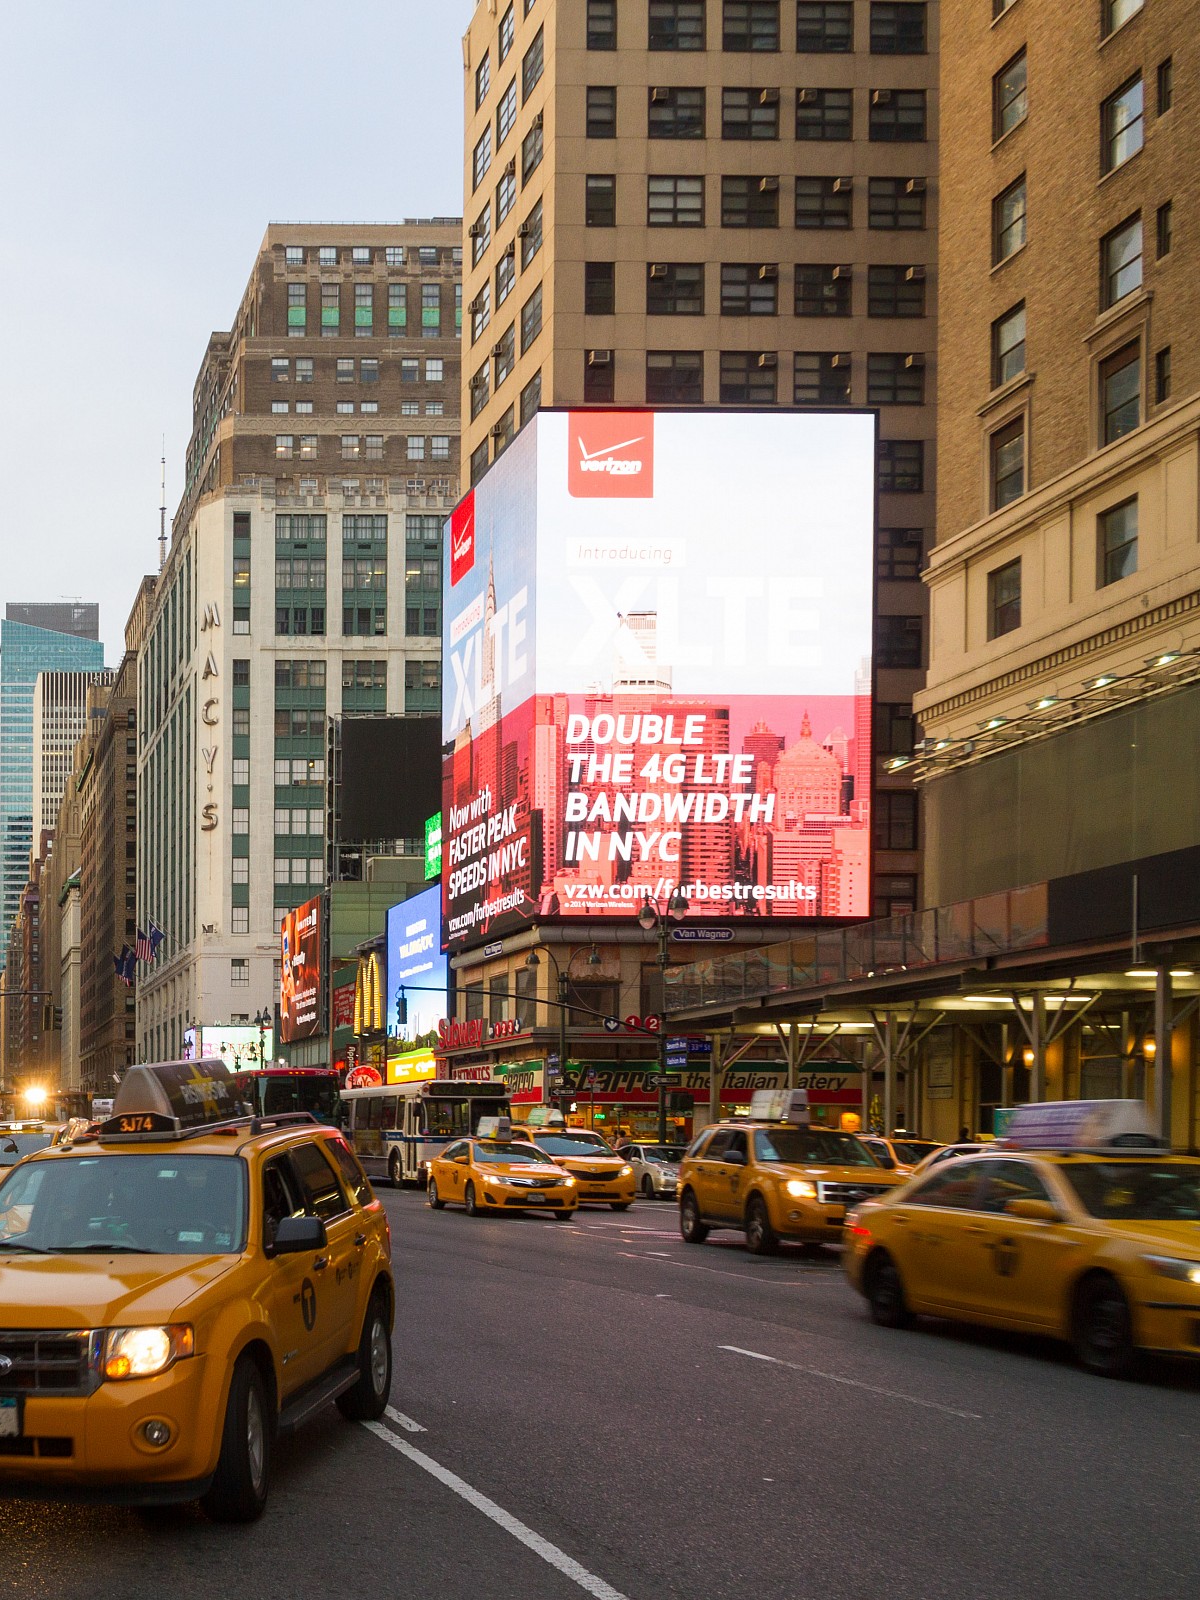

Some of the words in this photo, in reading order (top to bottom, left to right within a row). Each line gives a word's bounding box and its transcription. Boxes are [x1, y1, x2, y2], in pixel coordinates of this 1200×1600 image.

[580, 457, 642, 475] verizon
[454, 535, 472, 562] verizon
[578, 544, 674, 564] Introducing
[451, 585, 528, 733] XLTE
[566, 714, 707, 745] DOUBLE
[567, 753, 634, 783] THE
[640, 753, 687, 784] 4G
[694, 753, 755, 784] LTE
[449, 804, 469, 833] Now
[470, 784, 492, 821] with
[565, 792, 776, 823] BANDWIDTH
[448, 822, 487, 866] FASTER
[487, 803, 518, 846] PEAK
[565, 831, 600, 861] IN
[608, 831, 682, 862] NYC
[448, 856, 488, 900] SPEEDS
[488, 850, 500, 881] IN
[501, 836, 527, 875] NYC
[448, 887, 525, 932] vzw.com/forbestresults
[679, 930, 696, 938] Van
[697, 930, 731, 940] Wagner
[438, 1017, 483, 1048] Subway
[502, 1069, 535, 1094] sbarro
[566, 1065, 662, 1094] sbarro
[686, 1073, 711, 1089] the
[722, 1073, 778, 1089] Italian
[119, 1118, 153, 1132] 3J74
